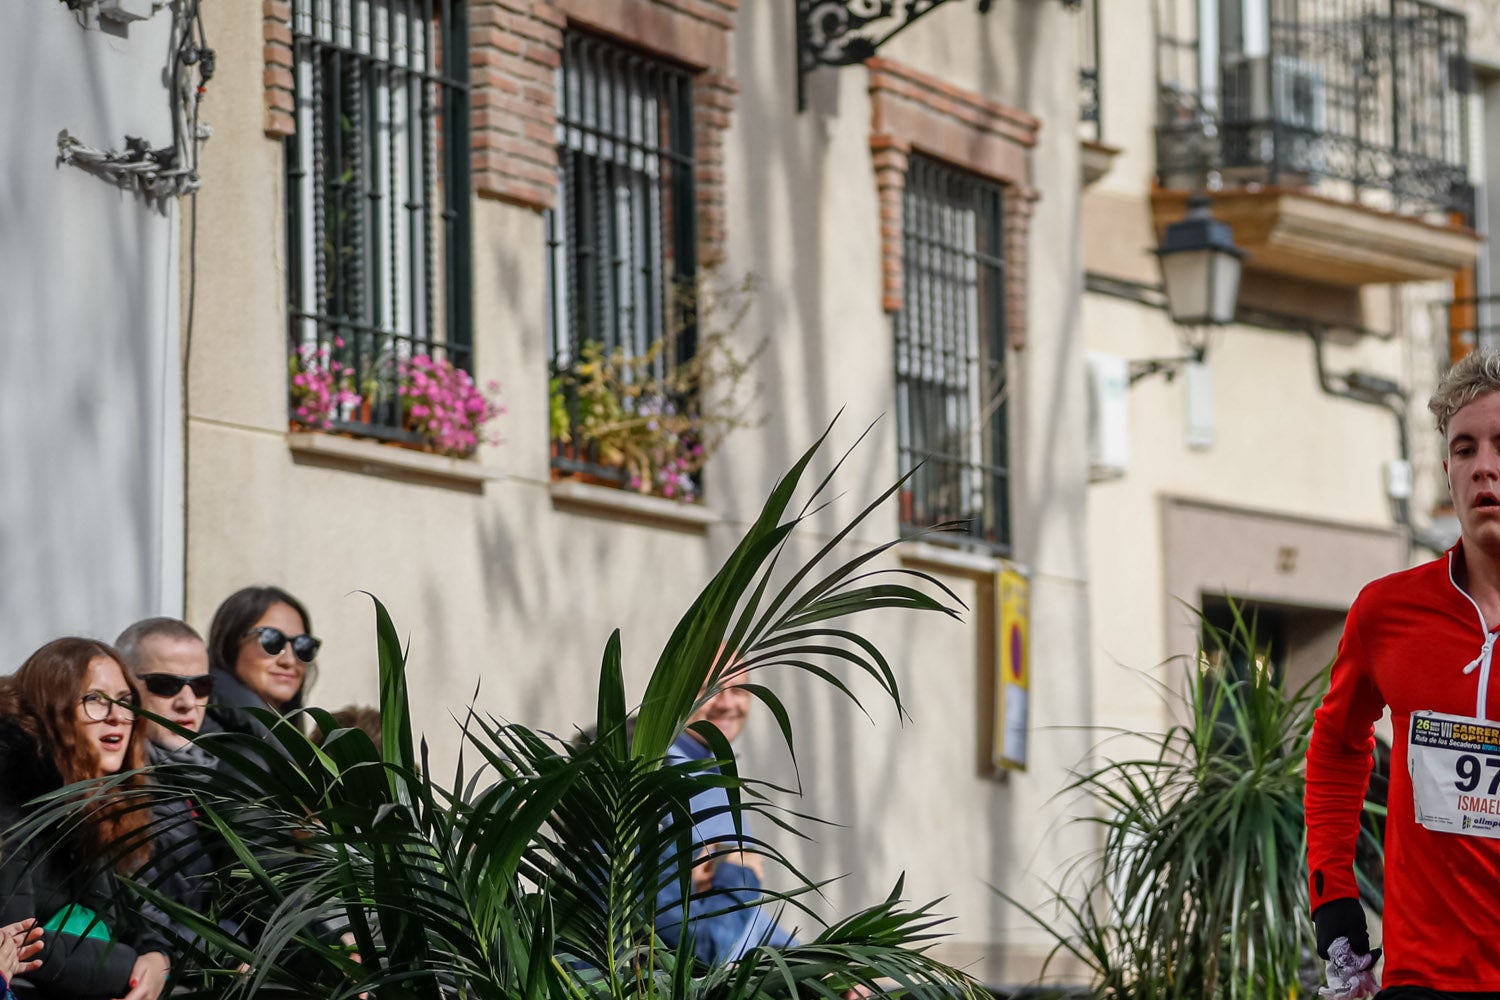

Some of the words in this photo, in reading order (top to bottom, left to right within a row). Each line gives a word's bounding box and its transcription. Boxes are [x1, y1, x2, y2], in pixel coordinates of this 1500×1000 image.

[1416, 719, 1430, 730] 26
[1441, 721, 1453, 738] VII
[1415, 734, 1428, 742] Ruta
[1438, 737, 1448, 745] los
[1449, 739, 1481, 750] Secaderos
